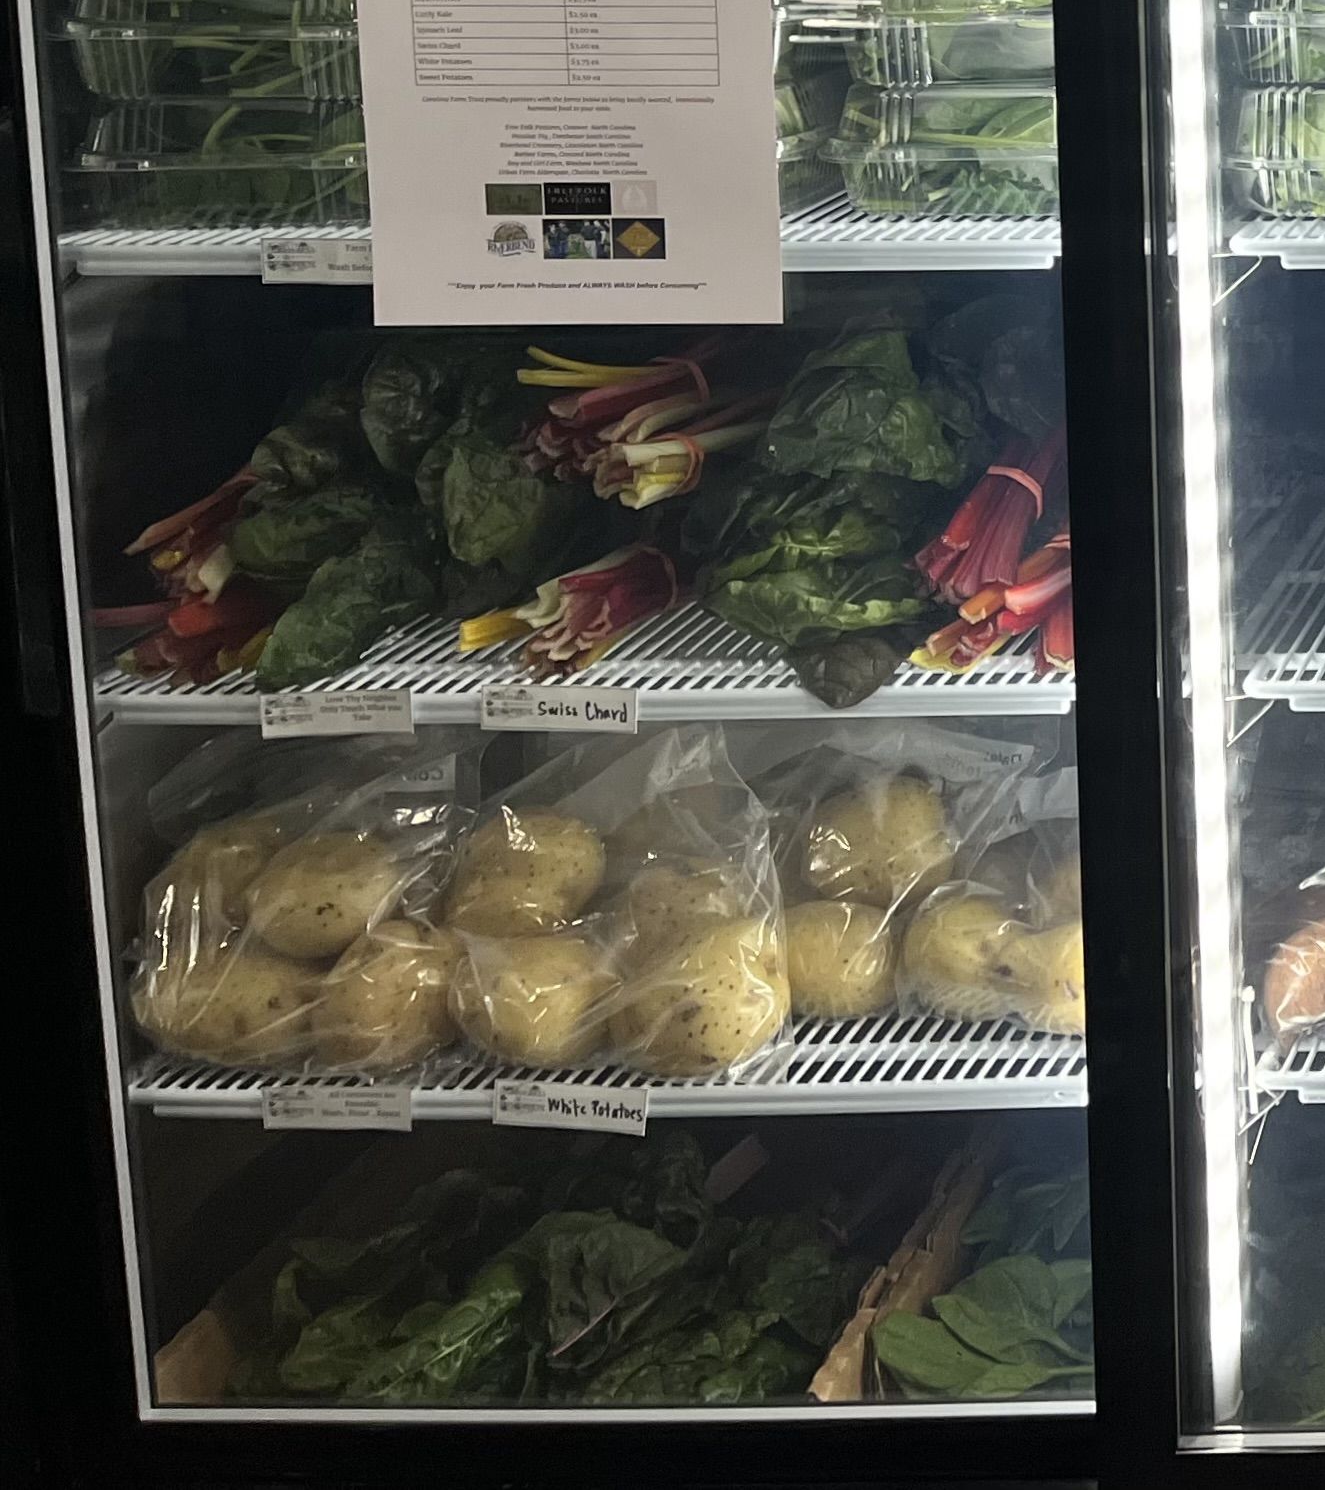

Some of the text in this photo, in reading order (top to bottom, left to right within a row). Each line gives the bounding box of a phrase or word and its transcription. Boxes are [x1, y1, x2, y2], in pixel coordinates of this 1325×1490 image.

[538, 702, 628, 723] Swiss Chard
[547, 1098, 643, 1123] White Potatoes
